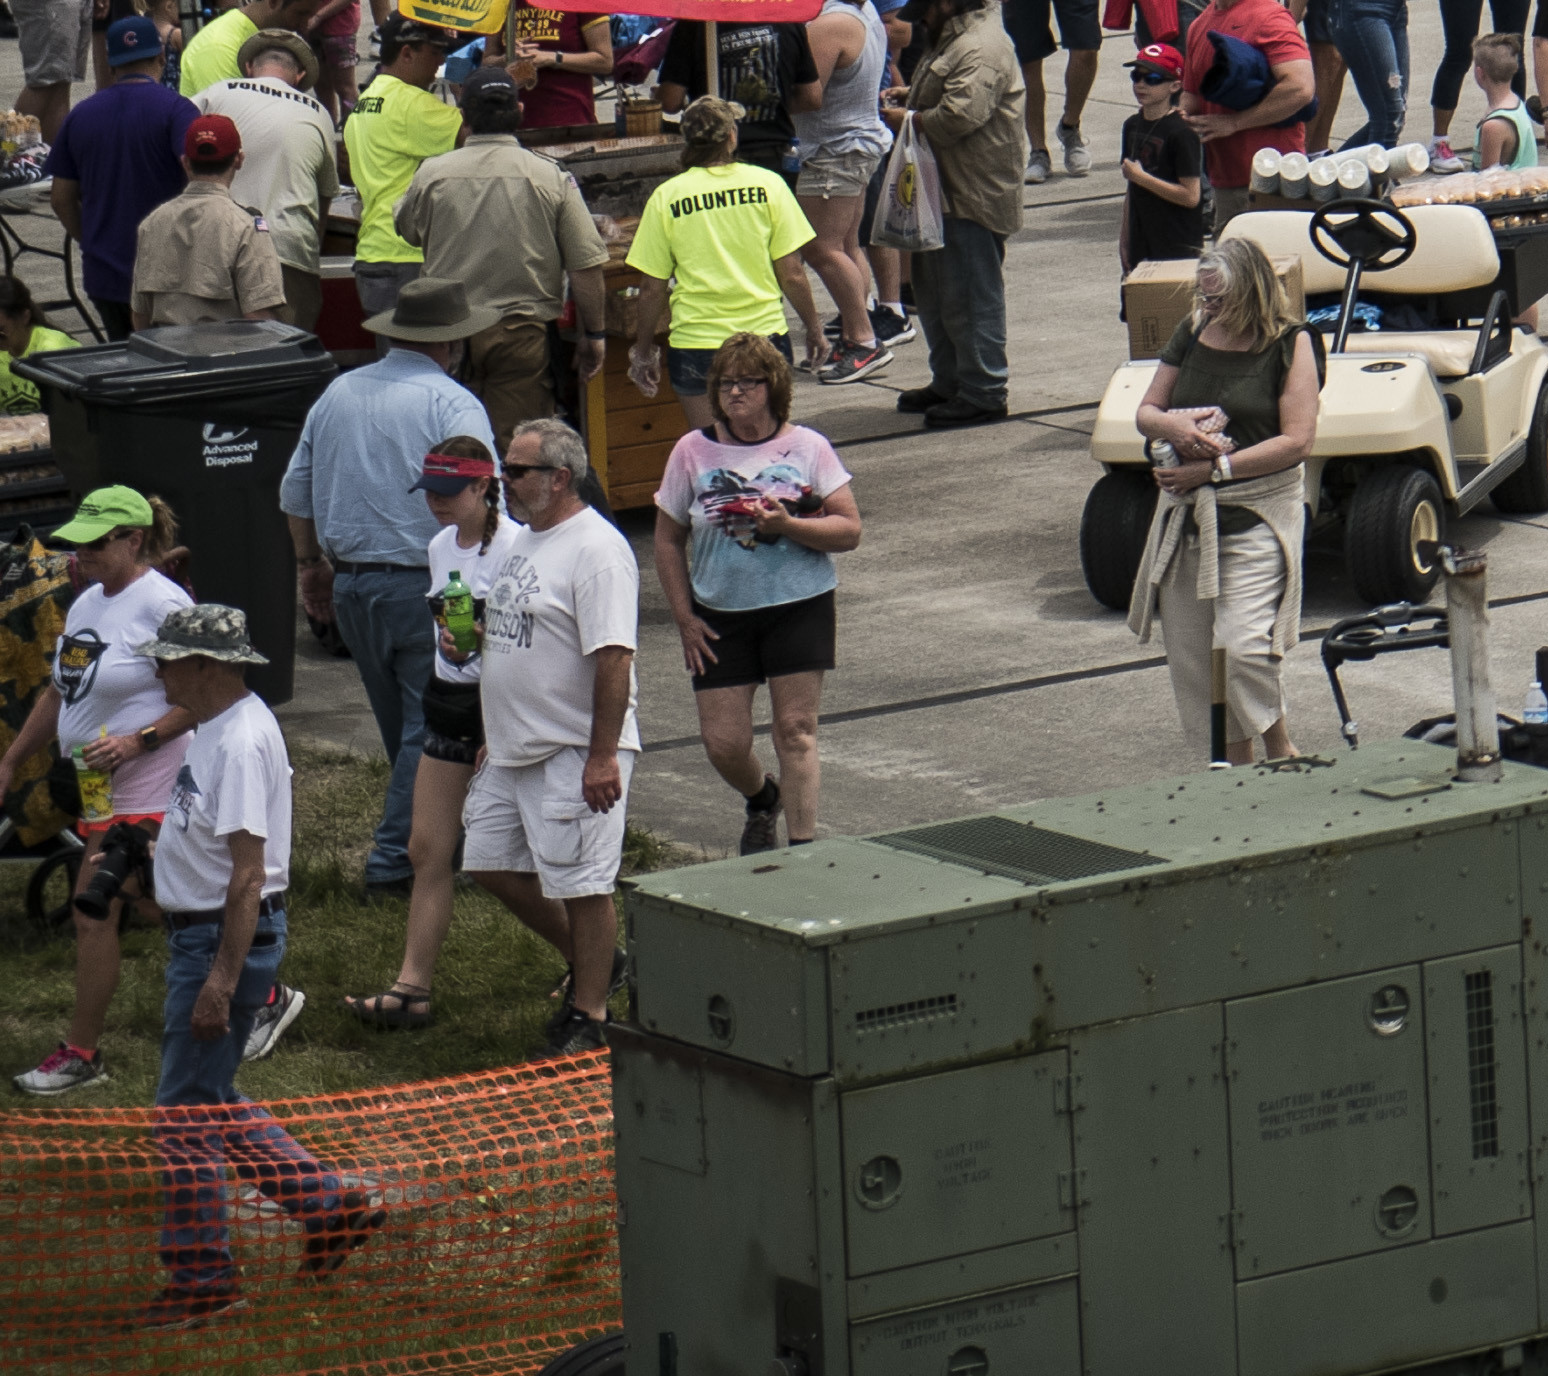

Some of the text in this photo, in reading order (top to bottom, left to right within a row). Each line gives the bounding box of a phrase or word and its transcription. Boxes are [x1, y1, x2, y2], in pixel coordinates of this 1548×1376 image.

[515, 8, 564, 22] NNYDALE
[228, 82, 320, 113] VOLUNTEER
[670, 187, 768, 218] VOLUNTEER
[203, 441, 258, 456] Advanced
[206, 453, 252, 467] Disposal
[499, 554, 541, 605] ARLEY
